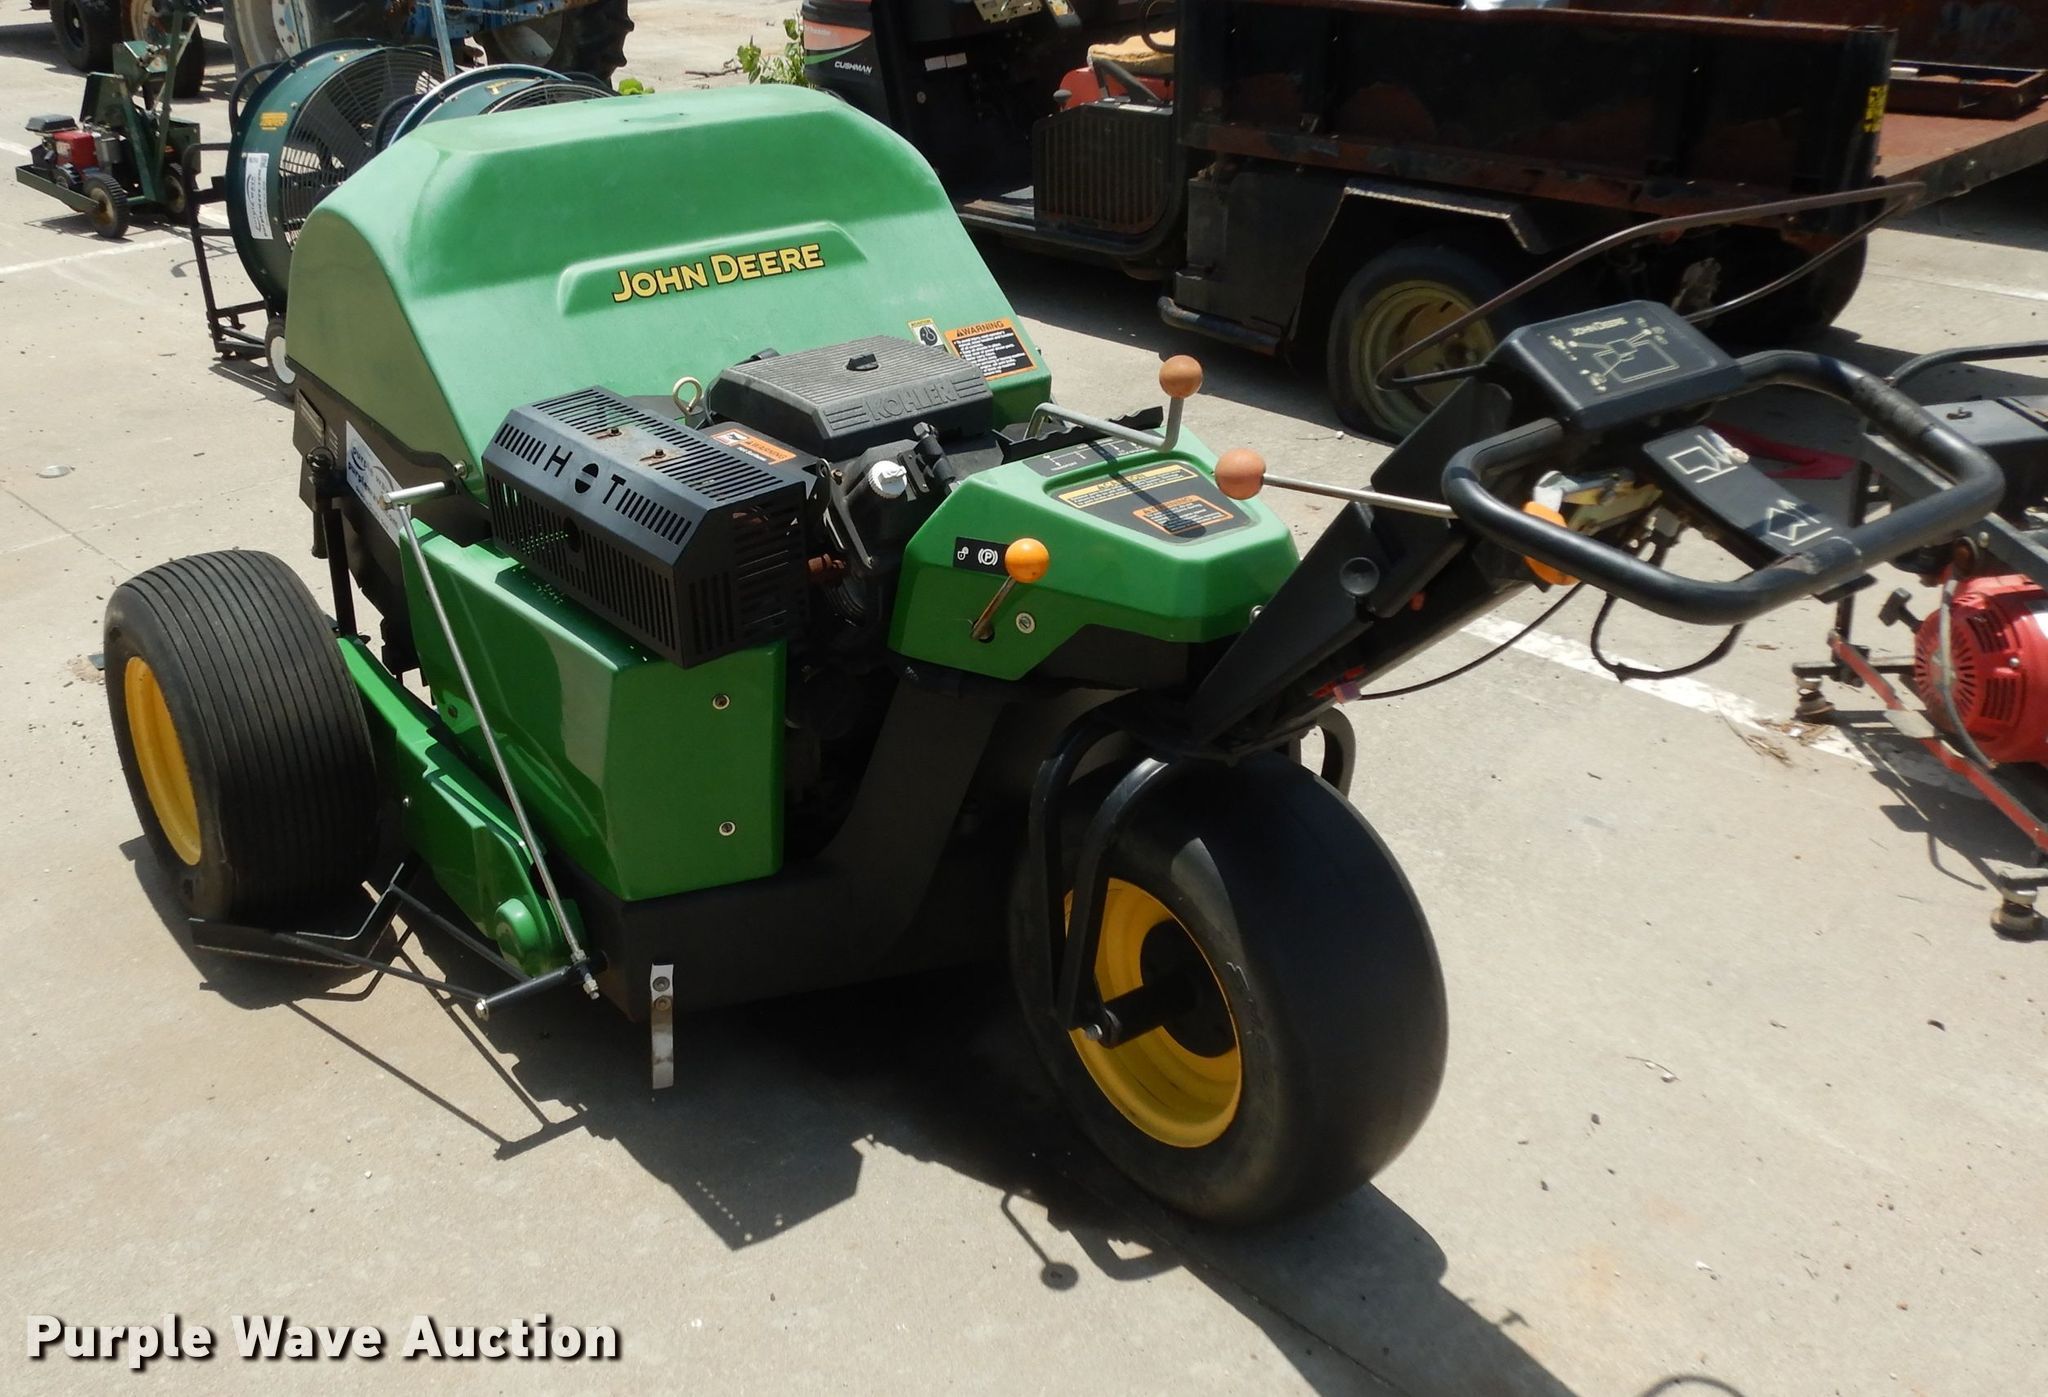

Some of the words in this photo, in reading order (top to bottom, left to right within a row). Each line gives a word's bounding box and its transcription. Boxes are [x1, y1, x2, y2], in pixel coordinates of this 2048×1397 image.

[834, 61, 872, 73] CUSHMAN
[613, 262, 709, 303] JOHN
[710, 243, 825, 284] DEERE
[962, 320, 1004, 336] WARNING
[865, 384, 957, 421] KOHLER
